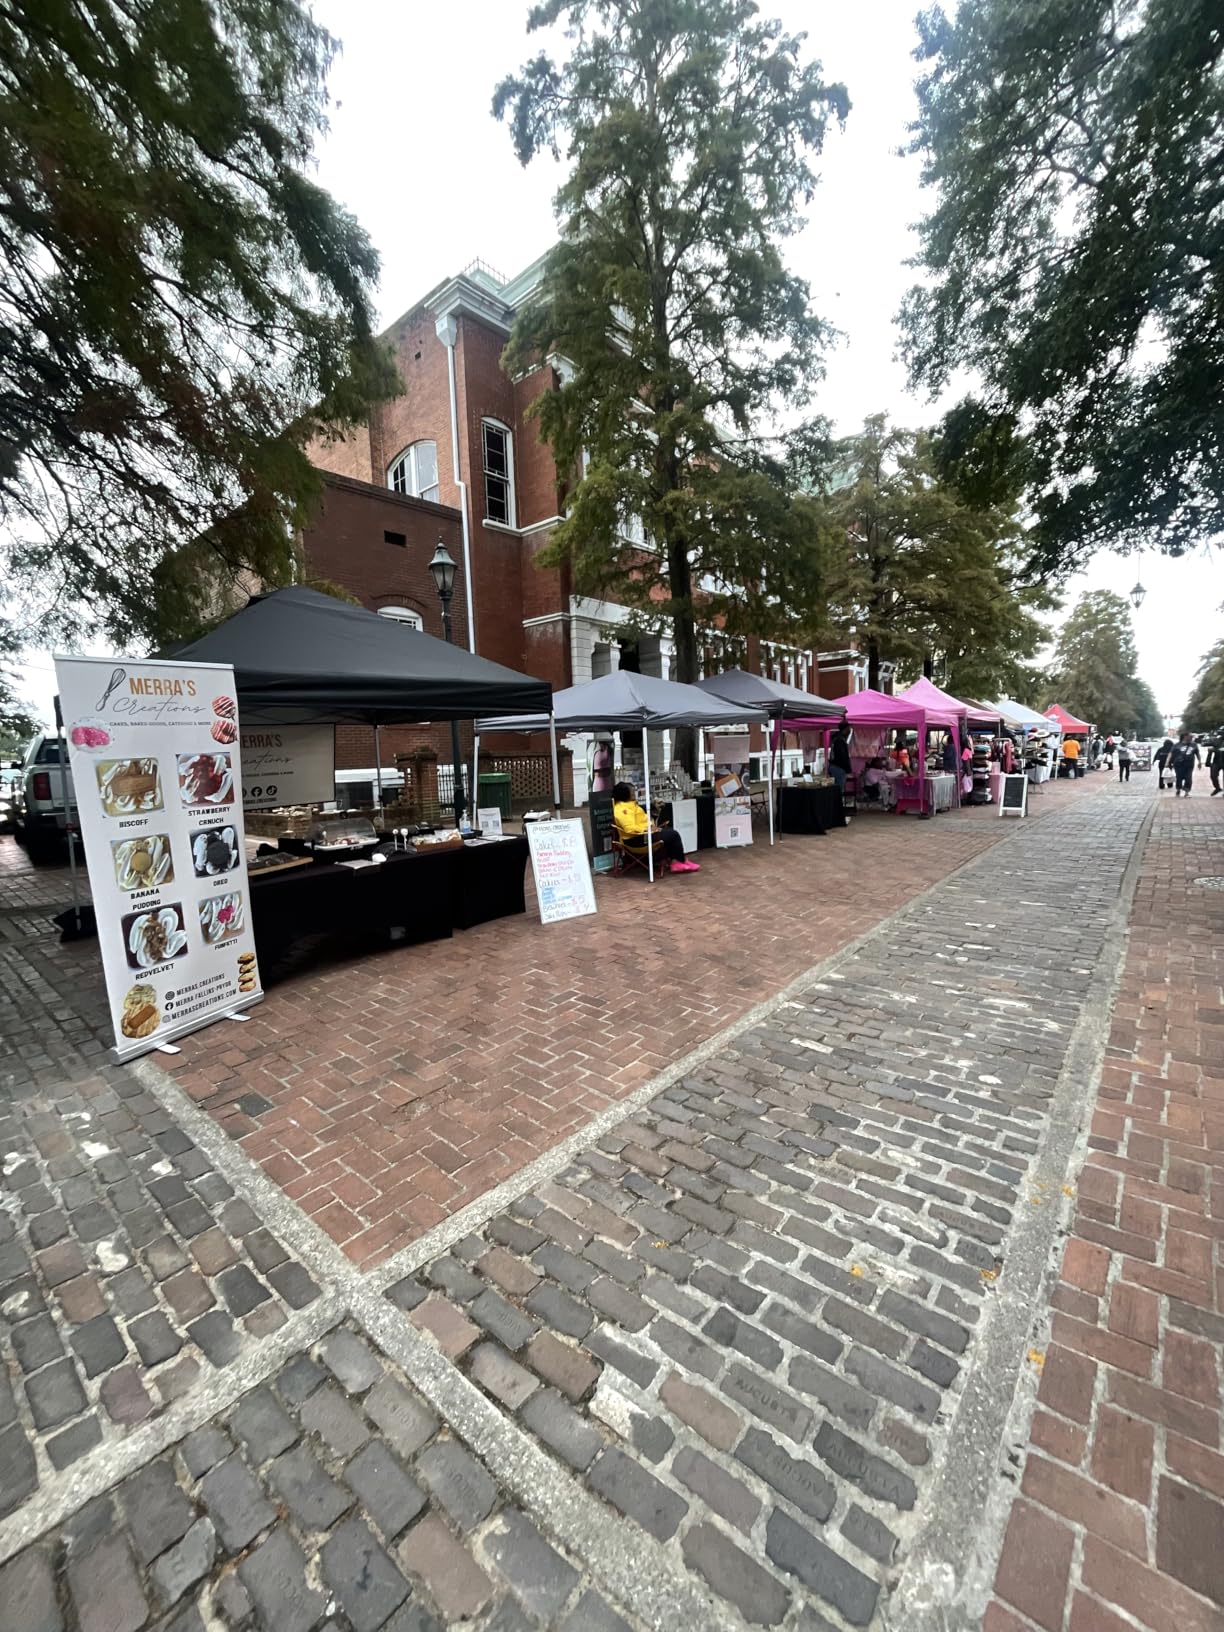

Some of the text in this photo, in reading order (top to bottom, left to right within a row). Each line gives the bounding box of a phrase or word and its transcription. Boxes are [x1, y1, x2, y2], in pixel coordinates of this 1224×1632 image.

[129, 677, 197, 697] MERRA'S
[112, 695, 207, 721] Creations
[240, 734, 282, 749] ERRA'S
[188, 806, 231, 817] STRAWBERRY
[119, 818, 149, 828] BISCOFF
[198, 817, 224, 826] CRNUCH
[213, 878, 228, 887] OREO
[130, 888, 160, 900] BANANA
[132, 899, 161, 911] PUDDING
[135, 962, 175, 981] REDVELVET
[175, 995, 194, 1008] MERRA
